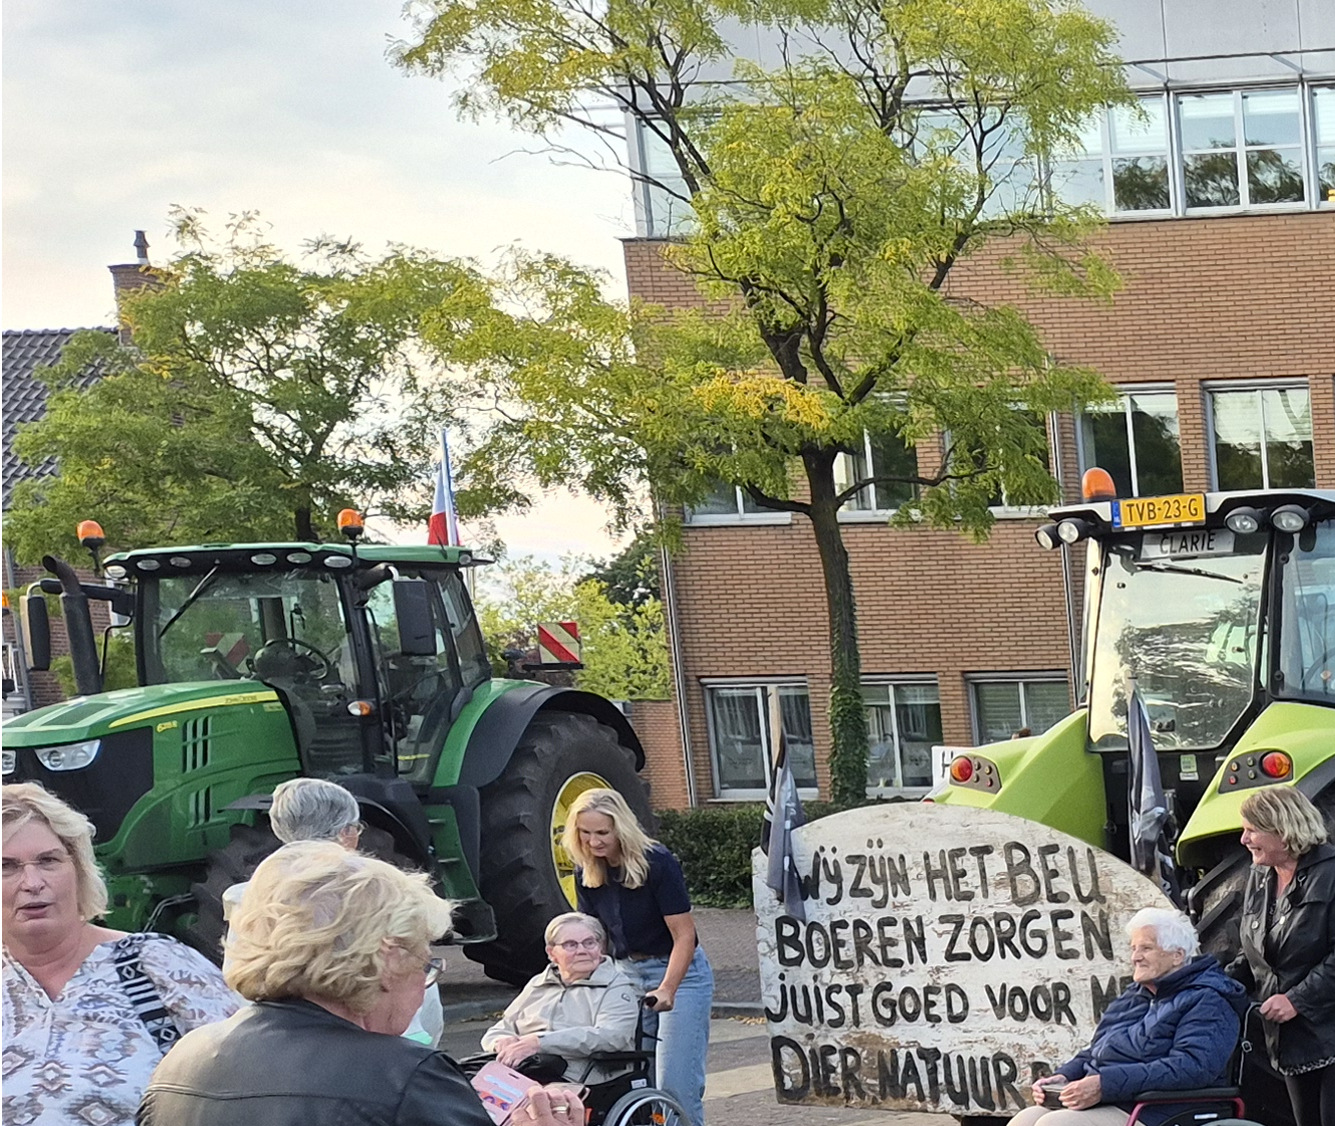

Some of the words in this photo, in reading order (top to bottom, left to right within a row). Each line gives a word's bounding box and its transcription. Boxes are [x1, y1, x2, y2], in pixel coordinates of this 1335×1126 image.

[1126, 498, 1198, 522] TVB-23-G
[923, 849, 994, 901] HET
[1003, 841, 1106, 908] BEU
[775, 912, 927, 969] BOEREN
[938, 908, 1113, 963] ZORGEN
[871, 981, 970, 1027] GOED
[984, 982, 1077, 1025] VOOR
[771, 1033, 868, 1101] DIER
[878, 1046, 1027, 1112] NATUUR
